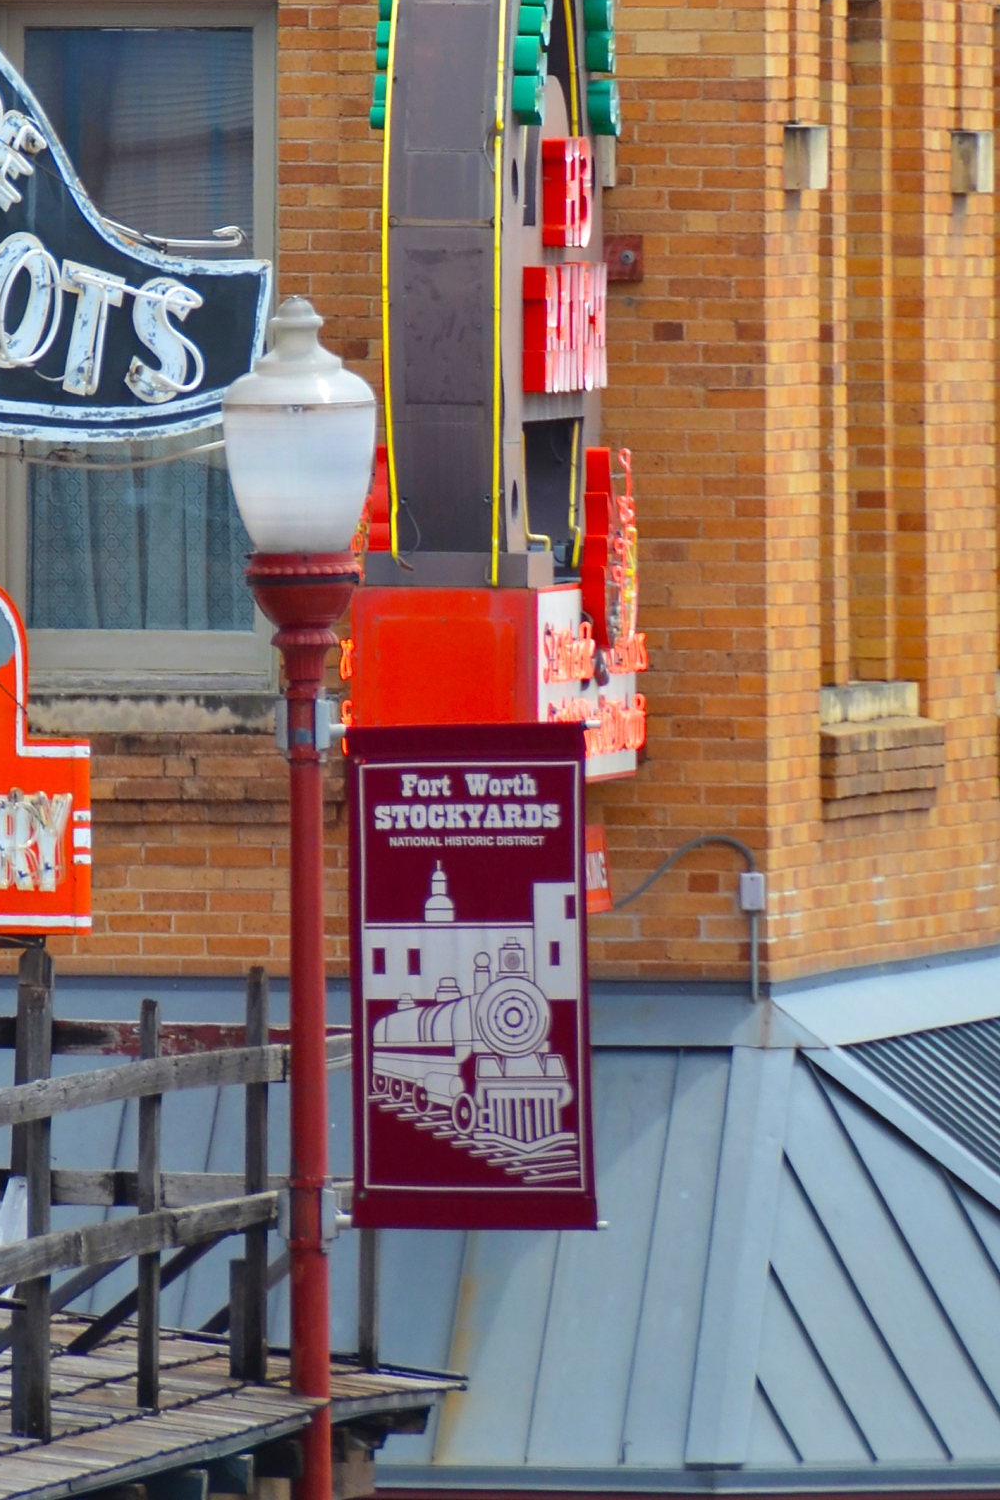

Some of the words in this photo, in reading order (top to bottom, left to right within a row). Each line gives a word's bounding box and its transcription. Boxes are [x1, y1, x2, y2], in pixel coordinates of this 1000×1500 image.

[401, 773, 452, 798] Fort
[464, 773, 537, 797] Worth
[374, 803, 561, 830] STOCKYARDS
[389, 836, 442, 848] NATIONAL
[445, 835, 495, 847] HISTORIC
[497, 835, 545, 847] DISTRICT
